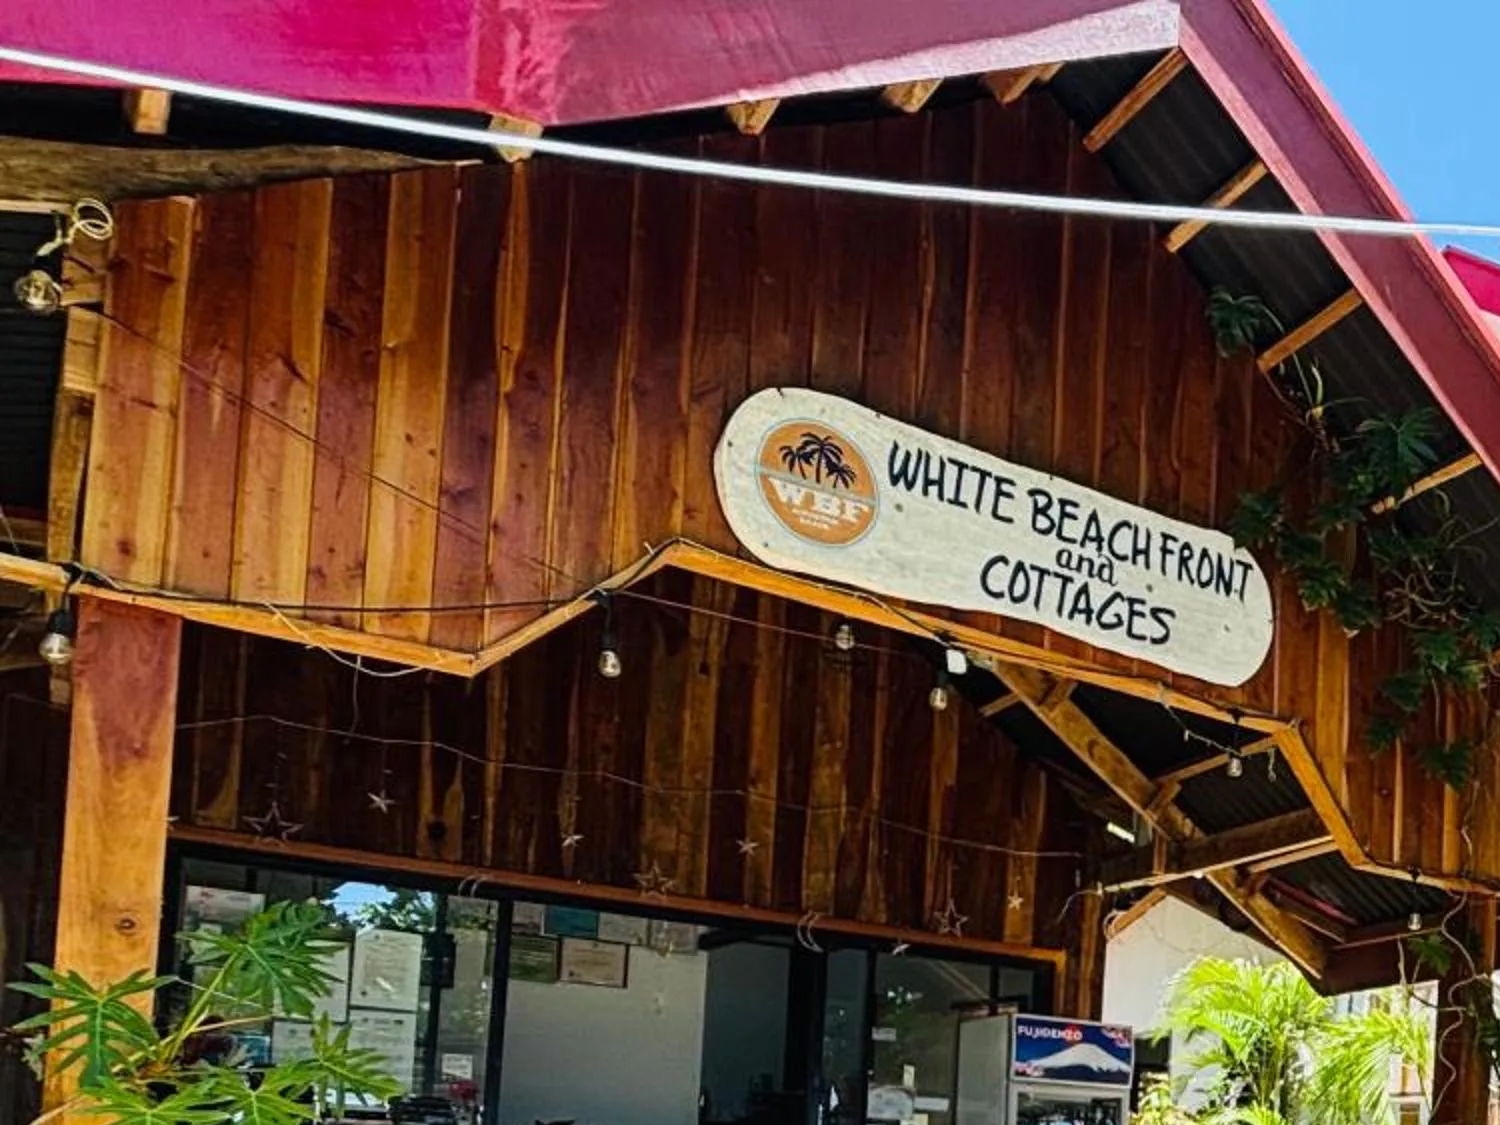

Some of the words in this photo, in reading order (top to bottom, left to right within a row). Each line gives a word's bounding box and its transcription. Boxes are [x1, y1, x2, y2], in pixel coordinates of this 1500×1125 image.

[767, 477, 870, 522] WBF
[888, 440, 1017, 524] WHITE
[1055, 547, 1118, 587] and
[980, 555, 1177, 645] COTTAGES
